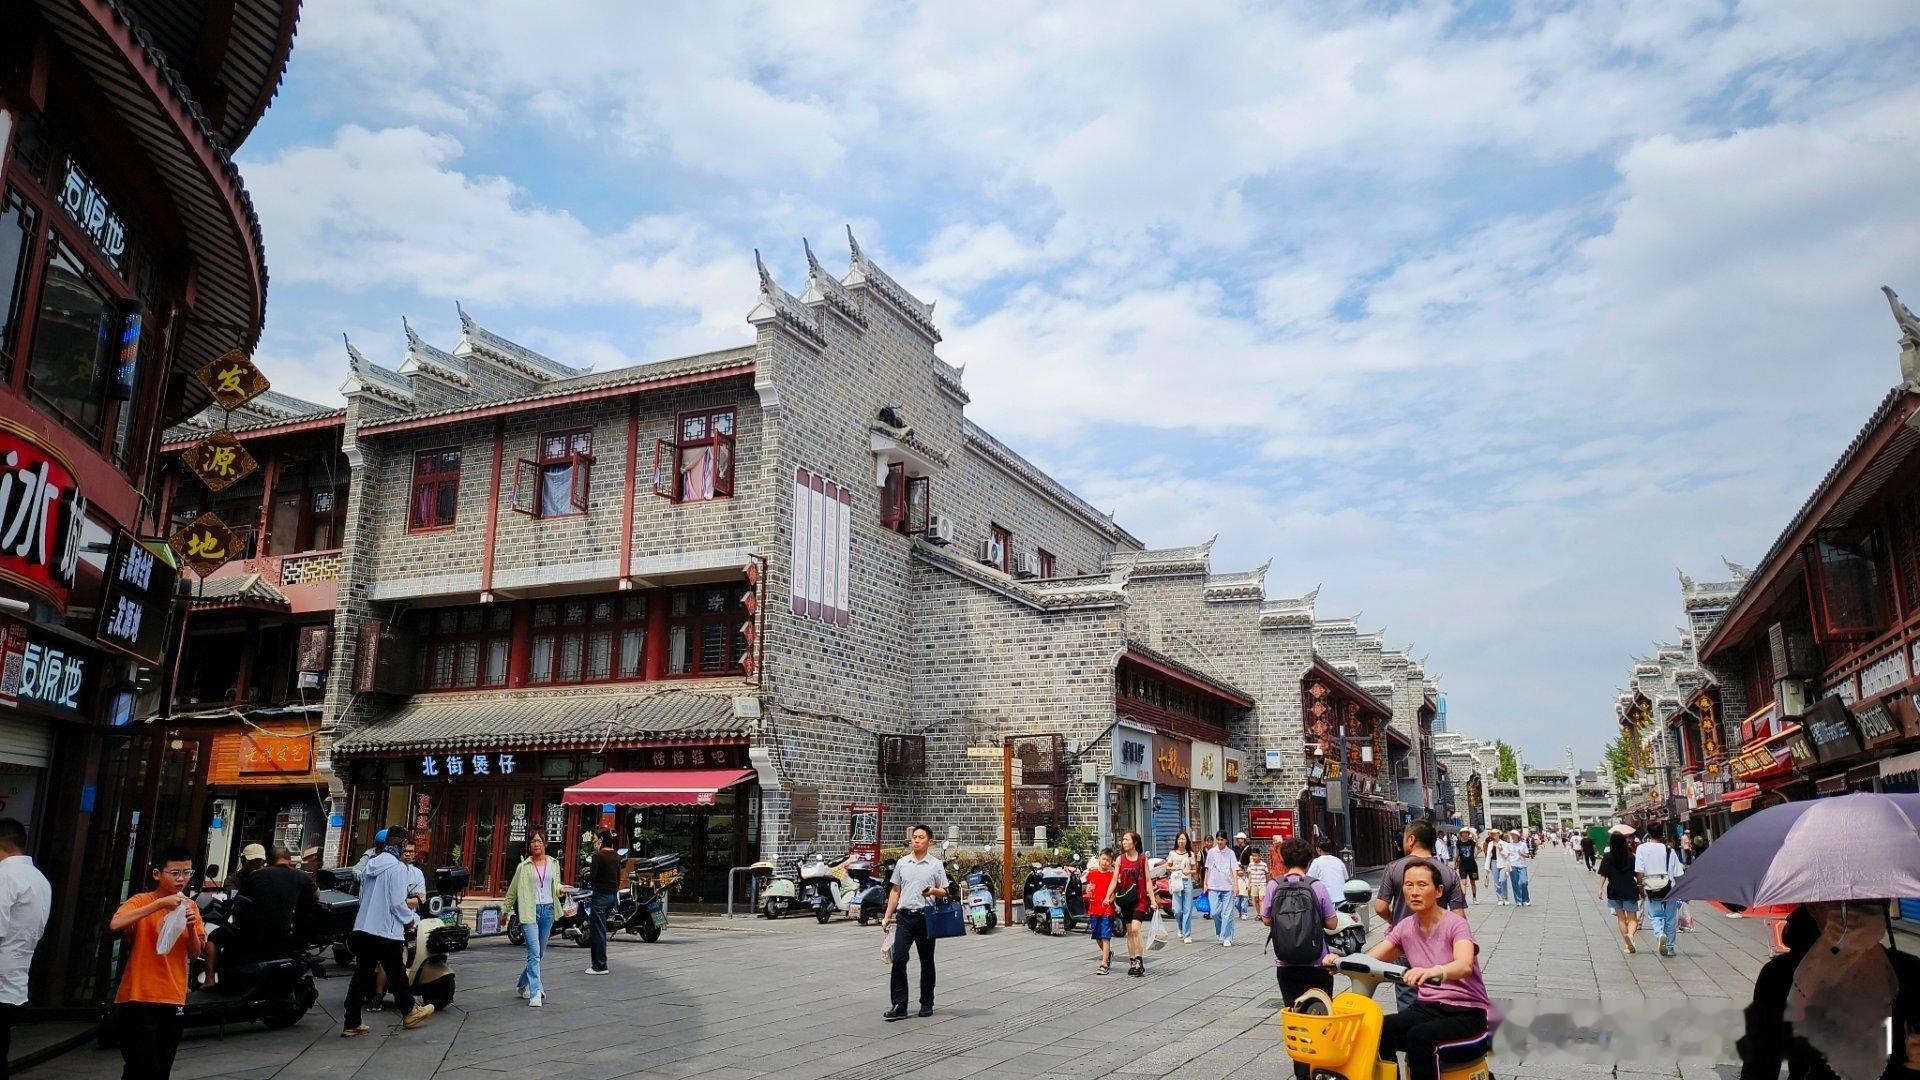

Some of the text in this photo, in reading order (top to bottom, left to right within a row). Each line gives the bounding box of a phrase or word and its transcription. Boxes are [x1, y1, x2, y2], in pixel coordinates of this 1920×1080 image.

[18, 641, 84, 708] 发源地
[422, 753, 517, 777] 北街煲仔
